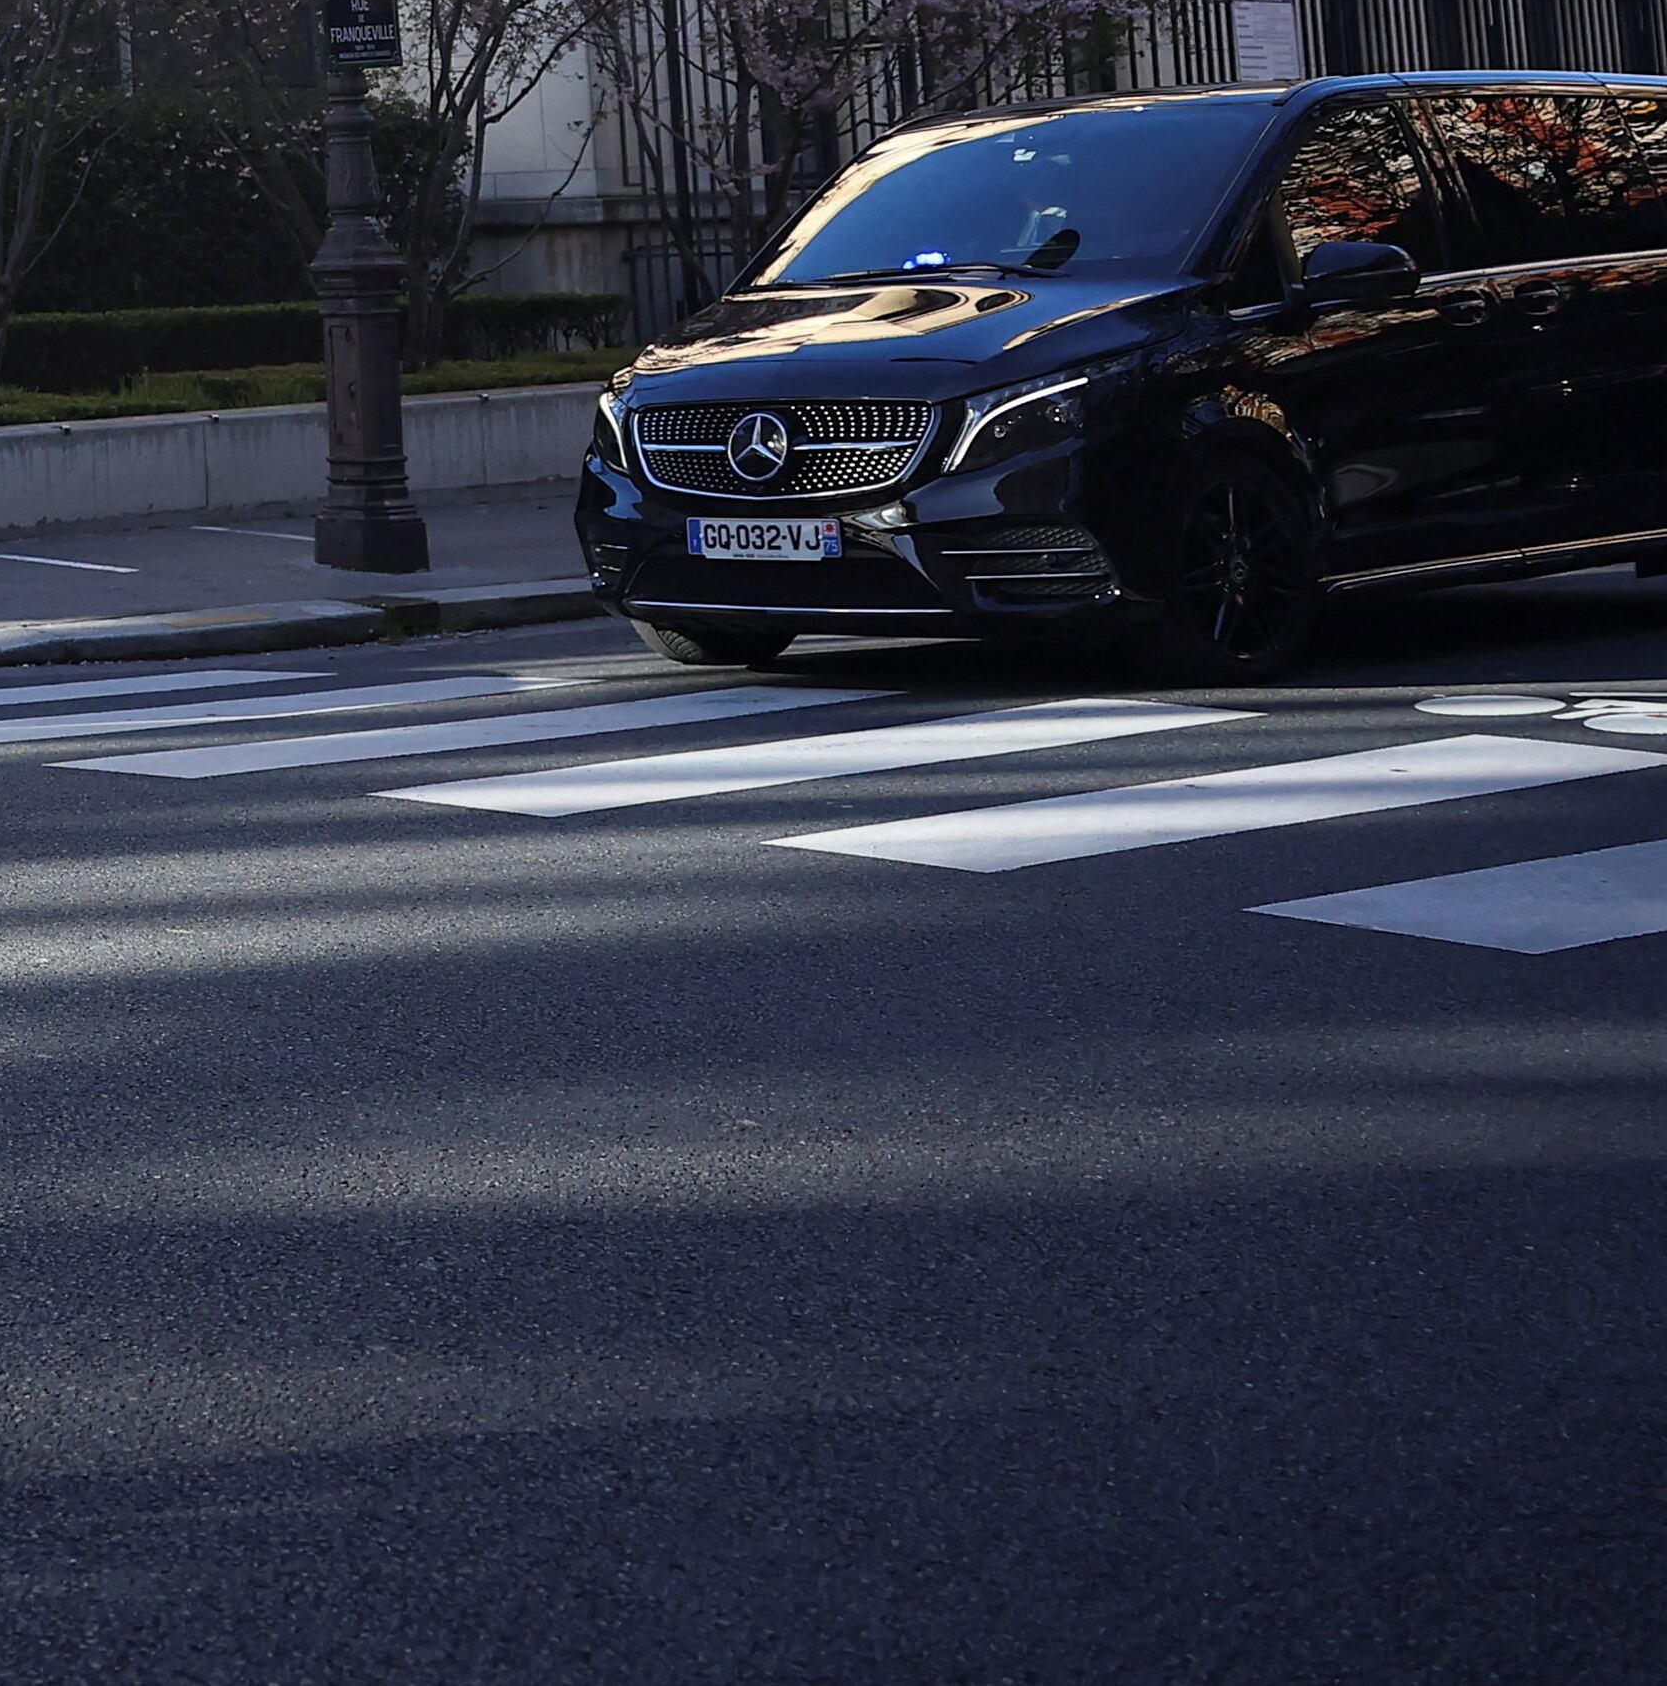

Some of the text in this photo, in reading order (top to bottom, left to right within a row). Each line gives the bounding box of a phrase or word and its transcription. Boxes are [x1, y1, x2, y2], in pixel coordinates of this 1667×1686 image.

[357, 13, 366, 23] DE
[330, 24, 396, 44] FRANQUEVILLE
[703, 523, 821, 551] GQ-032-VJ
[825, 539, 838, 553] 75
